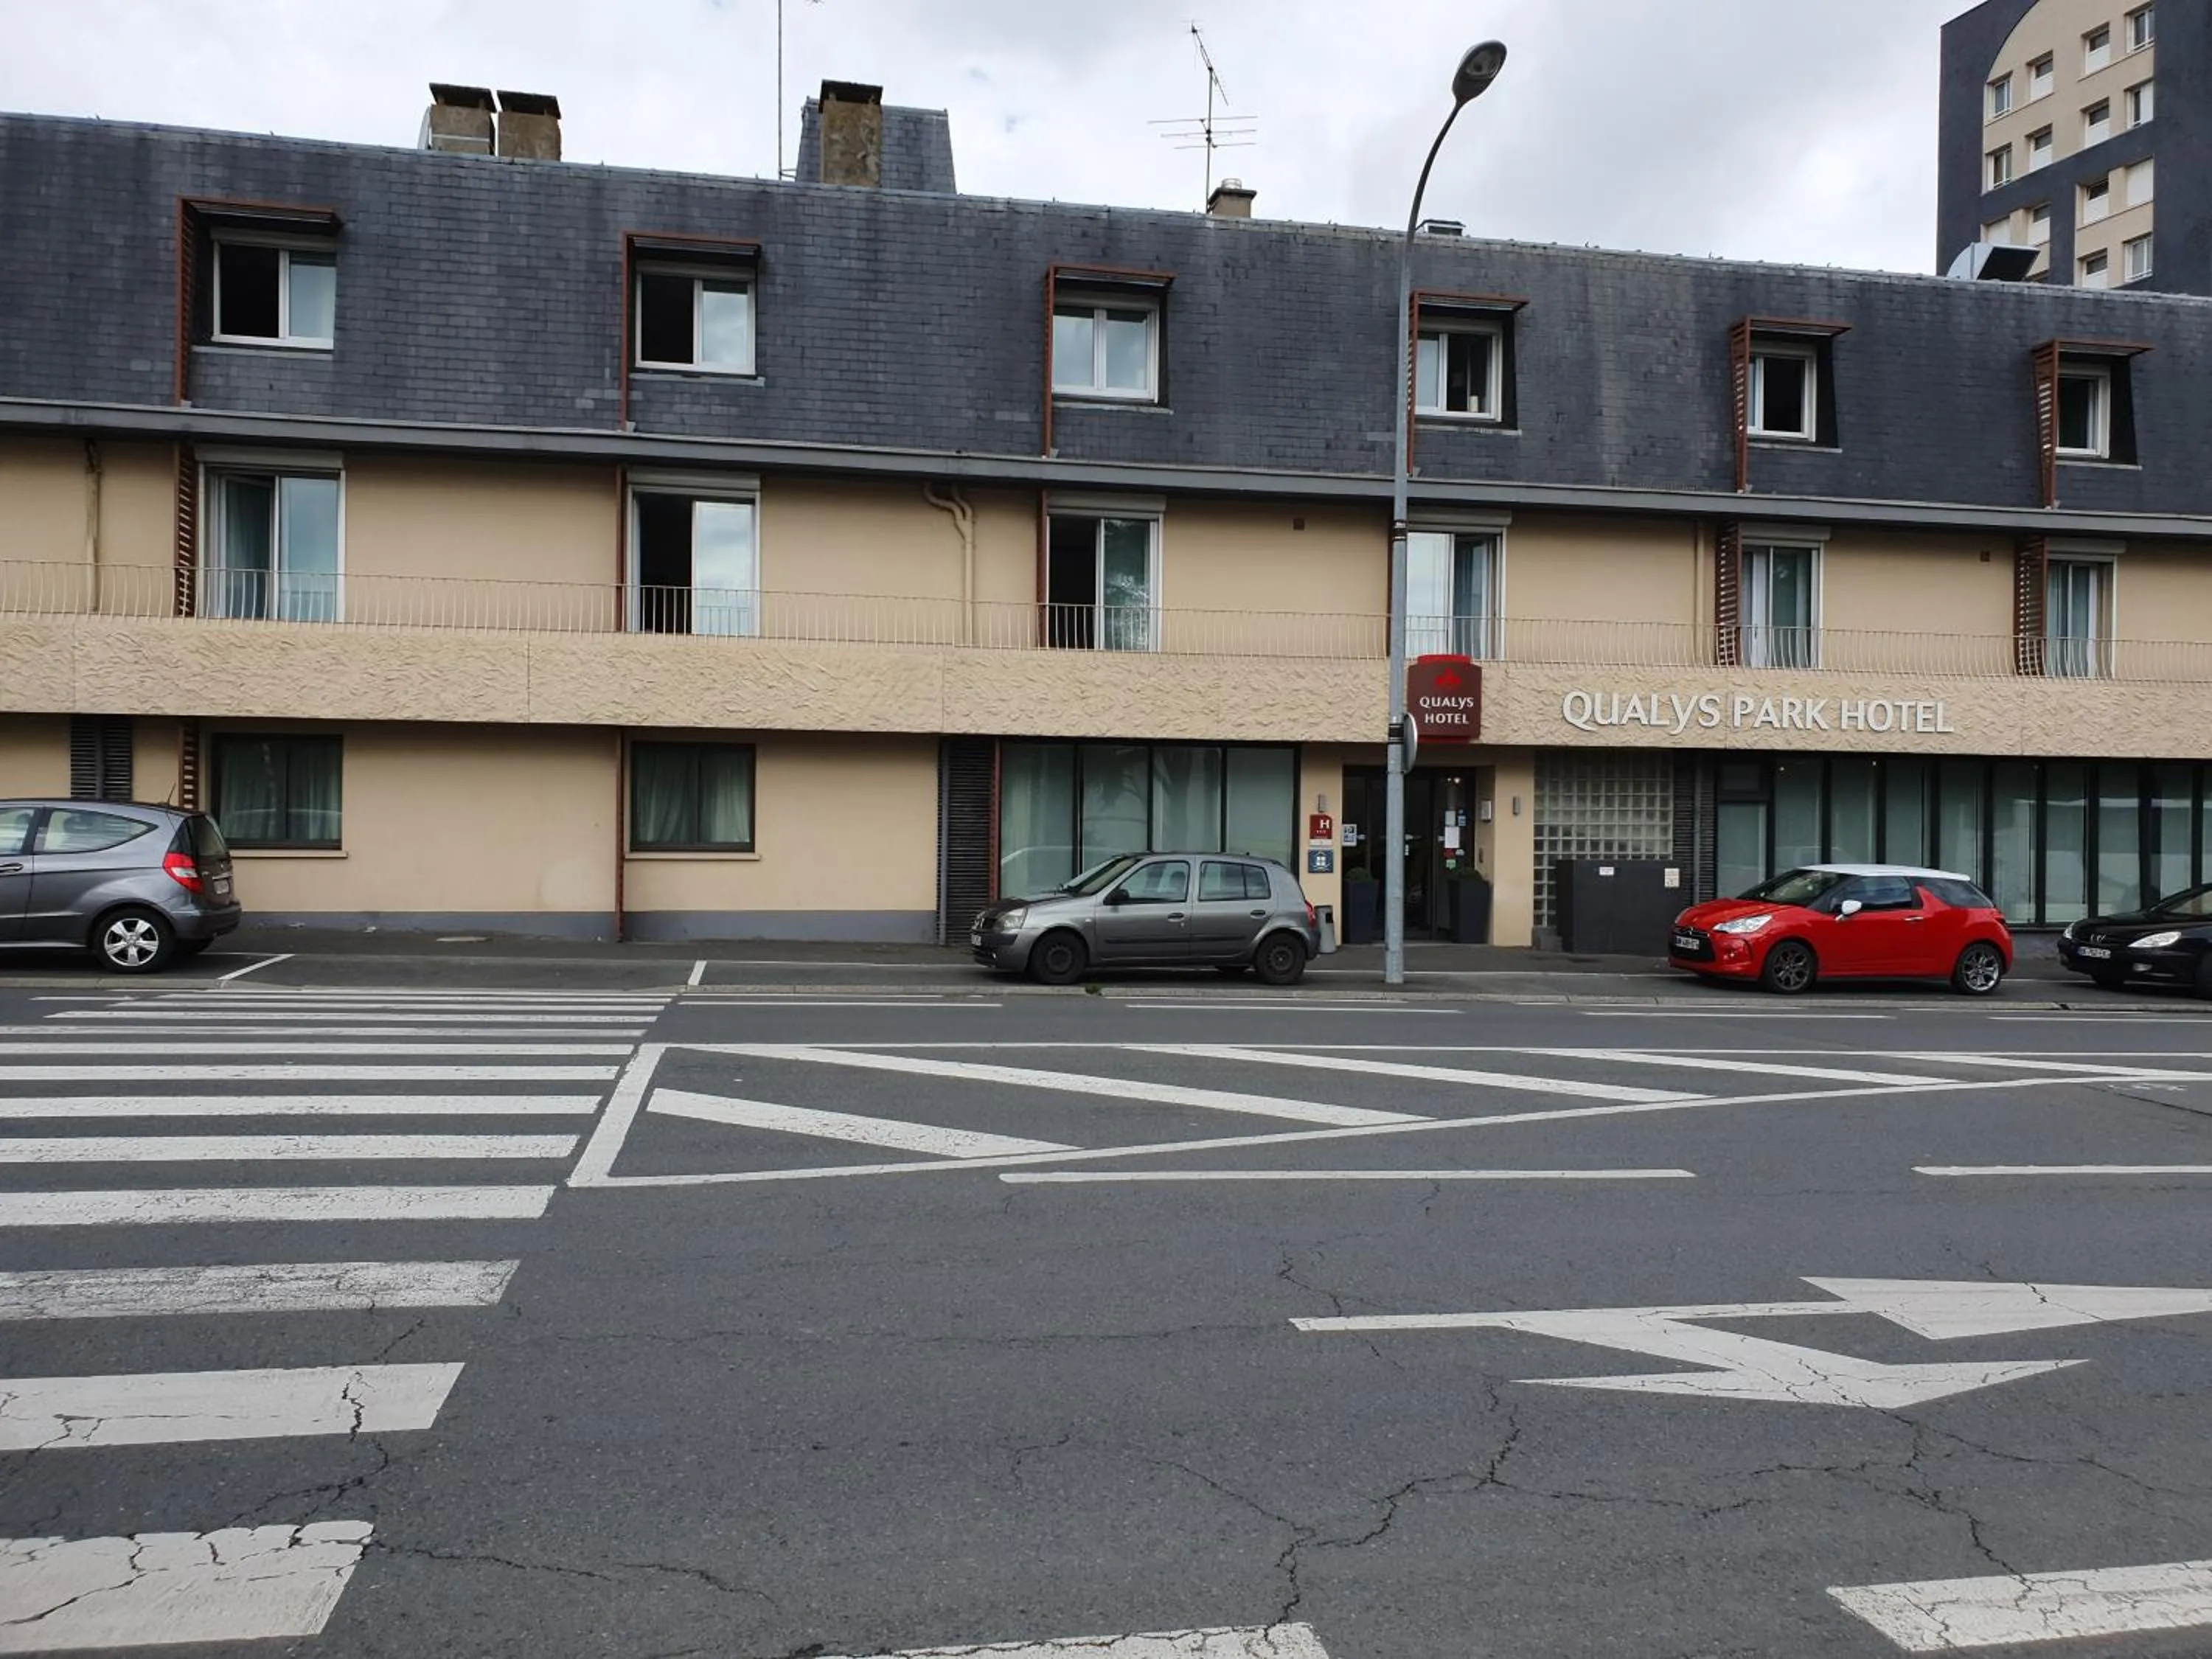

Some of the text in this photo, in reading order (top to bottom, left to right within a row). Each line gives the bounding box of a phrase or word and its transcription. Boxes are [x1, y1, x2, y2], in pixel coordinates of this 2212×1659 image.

[1425, 712, 1470, 725] HOTEL
[1733, 696, 1829, 731] PARK
[1840, 699, 1955, 734] HOTEL
[1320, 819, 1330, 830] H
